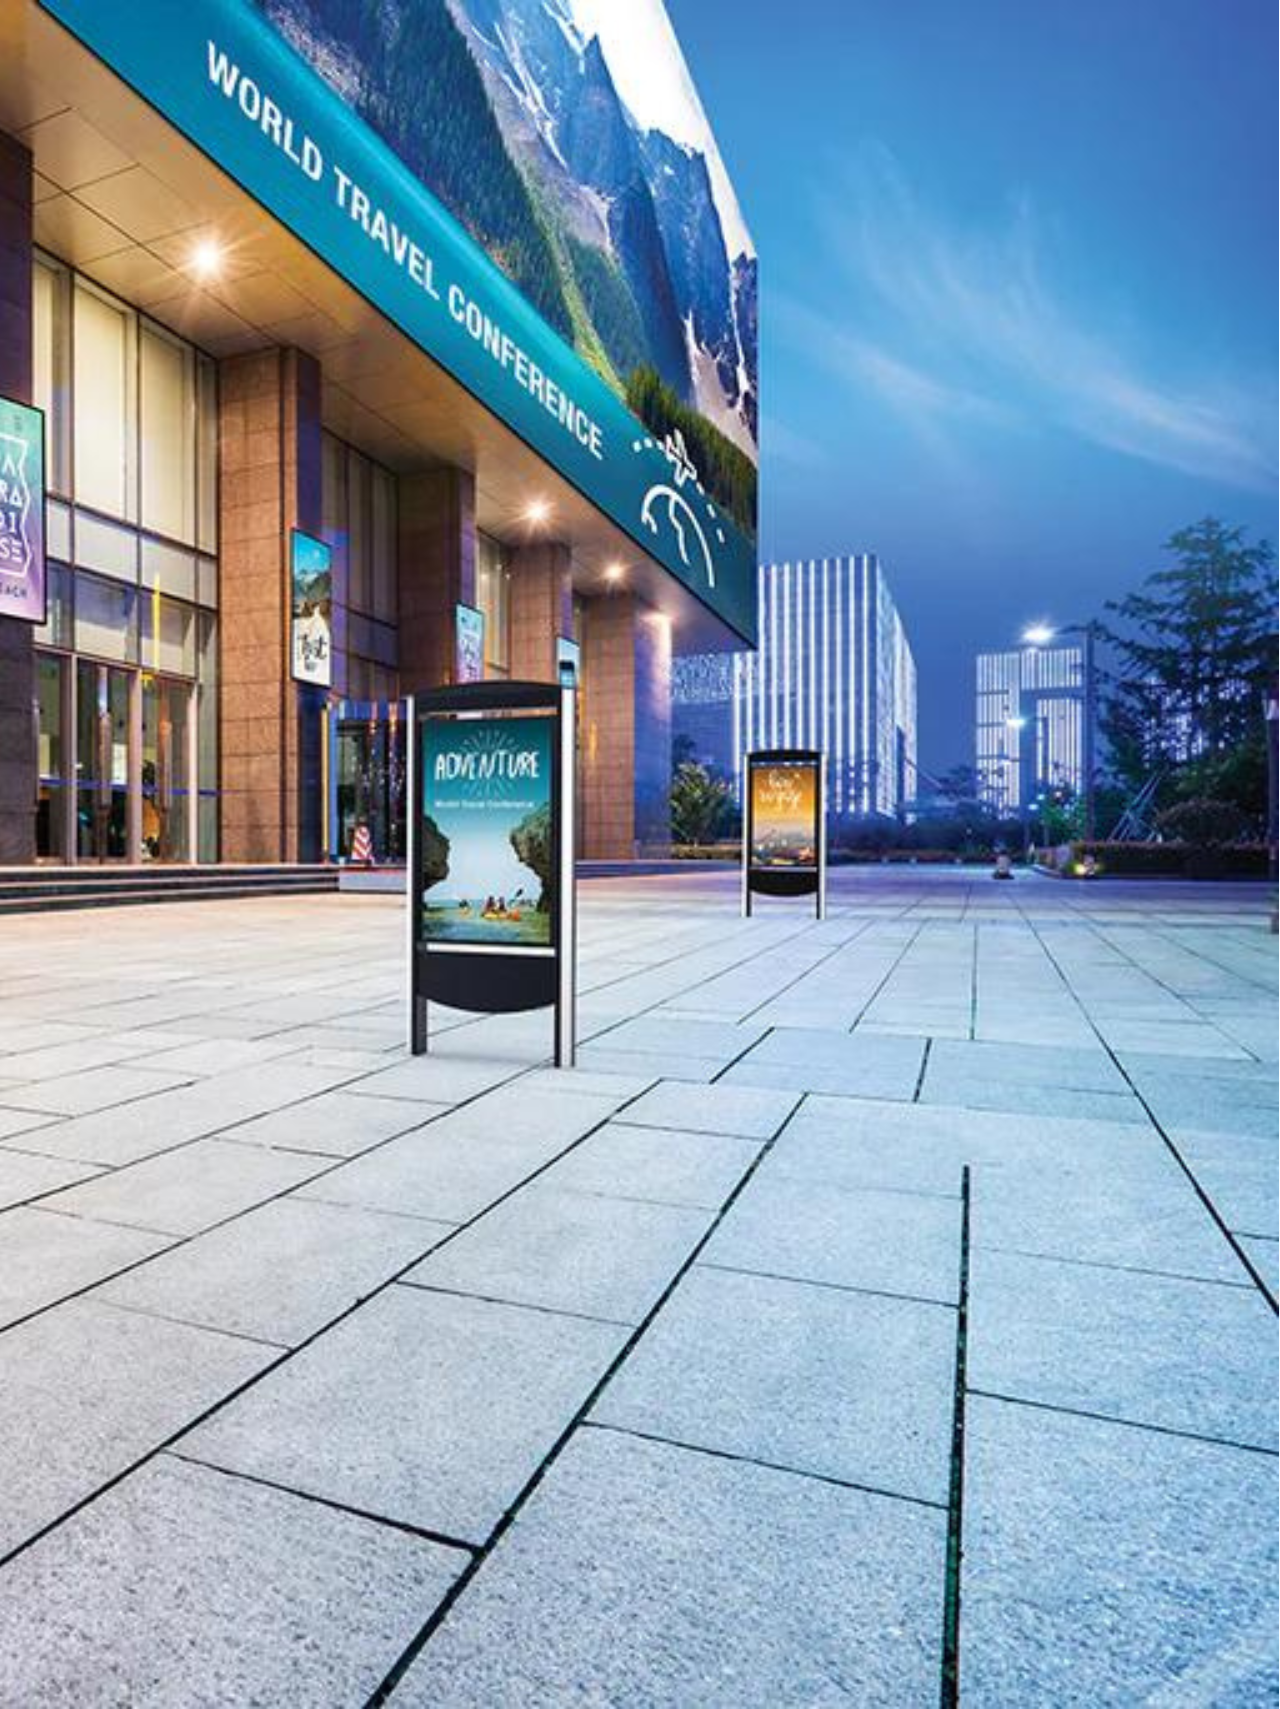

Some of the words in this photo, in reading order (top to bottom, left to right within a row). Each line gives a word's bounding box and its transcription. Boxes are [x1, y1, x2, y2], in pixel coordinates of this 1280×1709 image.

[206, 39, 323, 181] WORLD
[333, 165, 440, 300] TRAVEL
[448, 284, 603, 460] CONFERENCE
[434, 749, 540, 780] ADVENTURE
